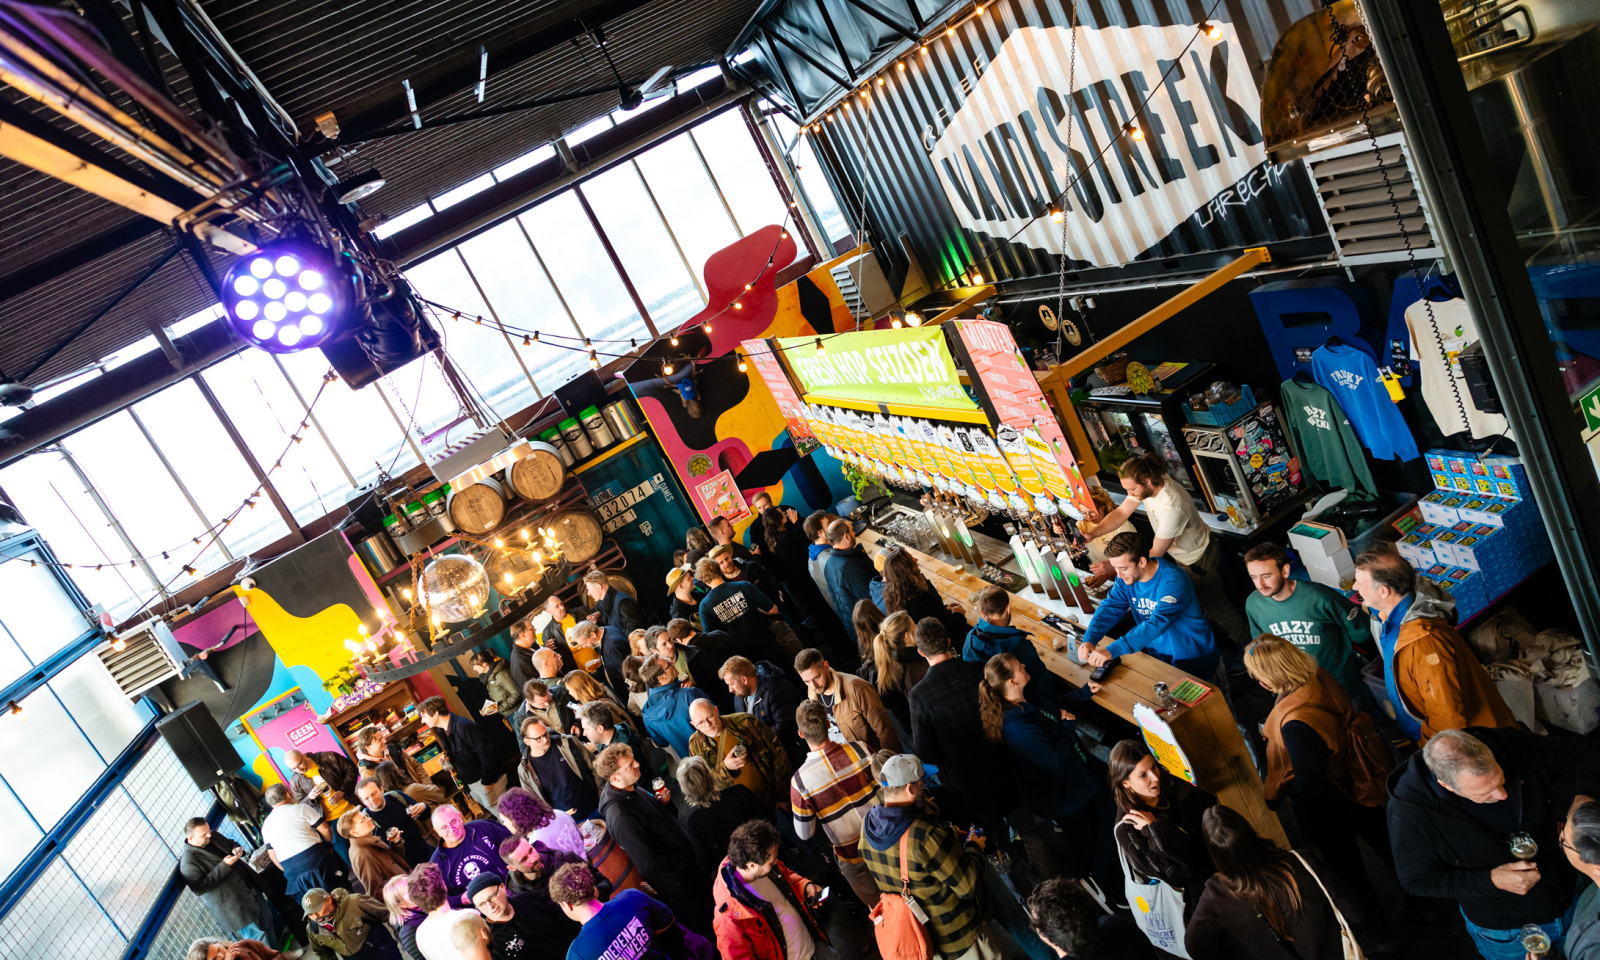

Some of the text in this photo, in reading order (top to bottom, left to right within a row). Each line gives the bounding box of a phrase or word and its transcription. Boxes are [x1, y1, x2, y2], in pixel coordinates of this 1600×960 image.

[941, 40, 1263, 224] VANDESTREEK
[962, 322, 1015, 355] MUNTEN
[794, 353, 836, 387] FRESH
[831, 350, 873, 386] HOP
[865, 338, 949, 385] SEIZOEN
[659, 481, 675, 503] DAMES
[700, 480, 718, 494] FRESH
[704, 488, 717, 501] HOP
[712, 595, 737, 616] BOEREN
[717, 599, 749, 623] BROUWERS
[1268, 620, 1314, 636] HAZY
[1282, 634, 1321, 645] EKEND
[290, 722, 315, 741] GEEN
